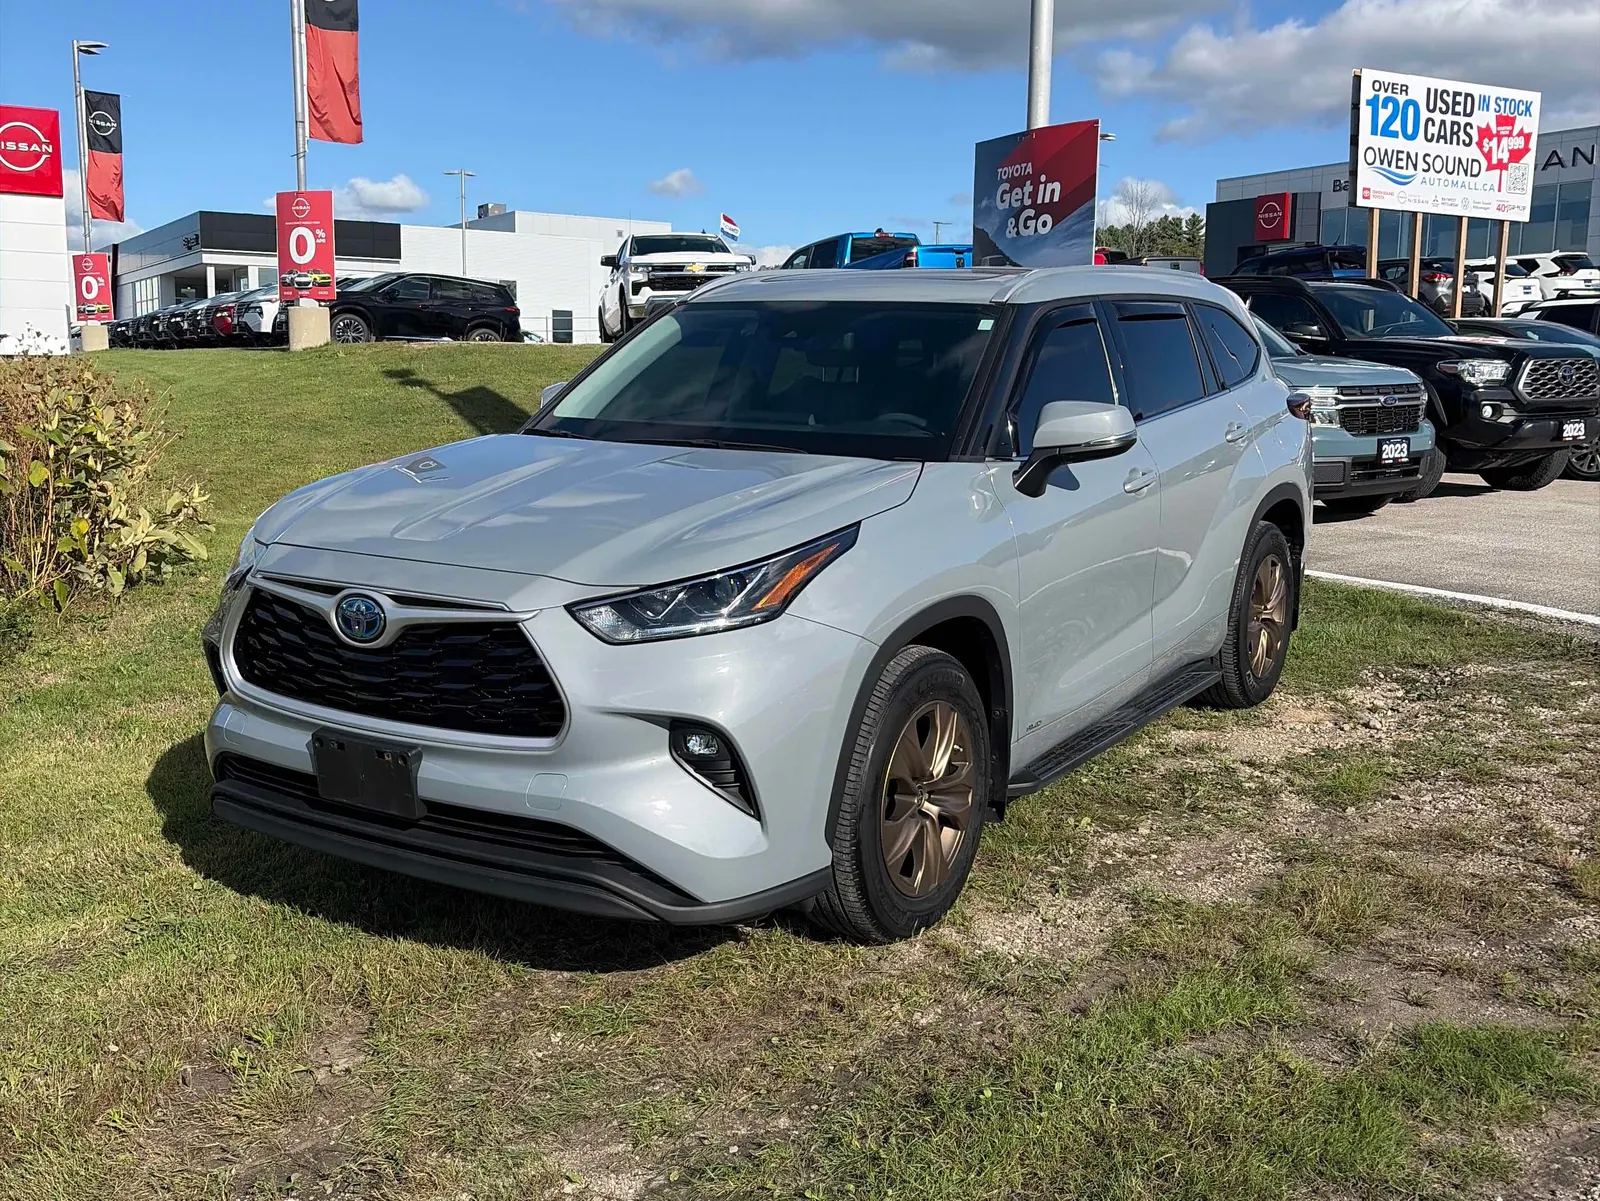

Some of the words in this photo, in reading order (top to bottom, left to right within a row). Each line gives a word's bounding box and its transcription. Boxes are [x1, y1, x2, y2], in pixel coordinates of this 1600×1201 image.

[1372, 79, 1409, 96] OVER
[1425, 87, 1475, 118] USED
[1478, 94, 1492, 112] IN
[1494, 96, 1533, 117] STOCK
[1366, 94, 1421, 141] 120
[1424, 117, 1473, 147] CARS
[0, 141, 52, 153] ISSAN
[997, 161, 1033, 181] TOYOTA
[1364, 146, 1418, 172] OWEN
[1422, 153, 1482, 178] SOUND
[995, 180, 1033, 210] Get
[1037, 174, 1061, 204] in
[1006, 208, 1053, 239] &Go
[1258, 211, 1282, 219] NISSAN
[1563, 422, 1585, 437] 2023
[1382, 443, 1408, 459] 2023
